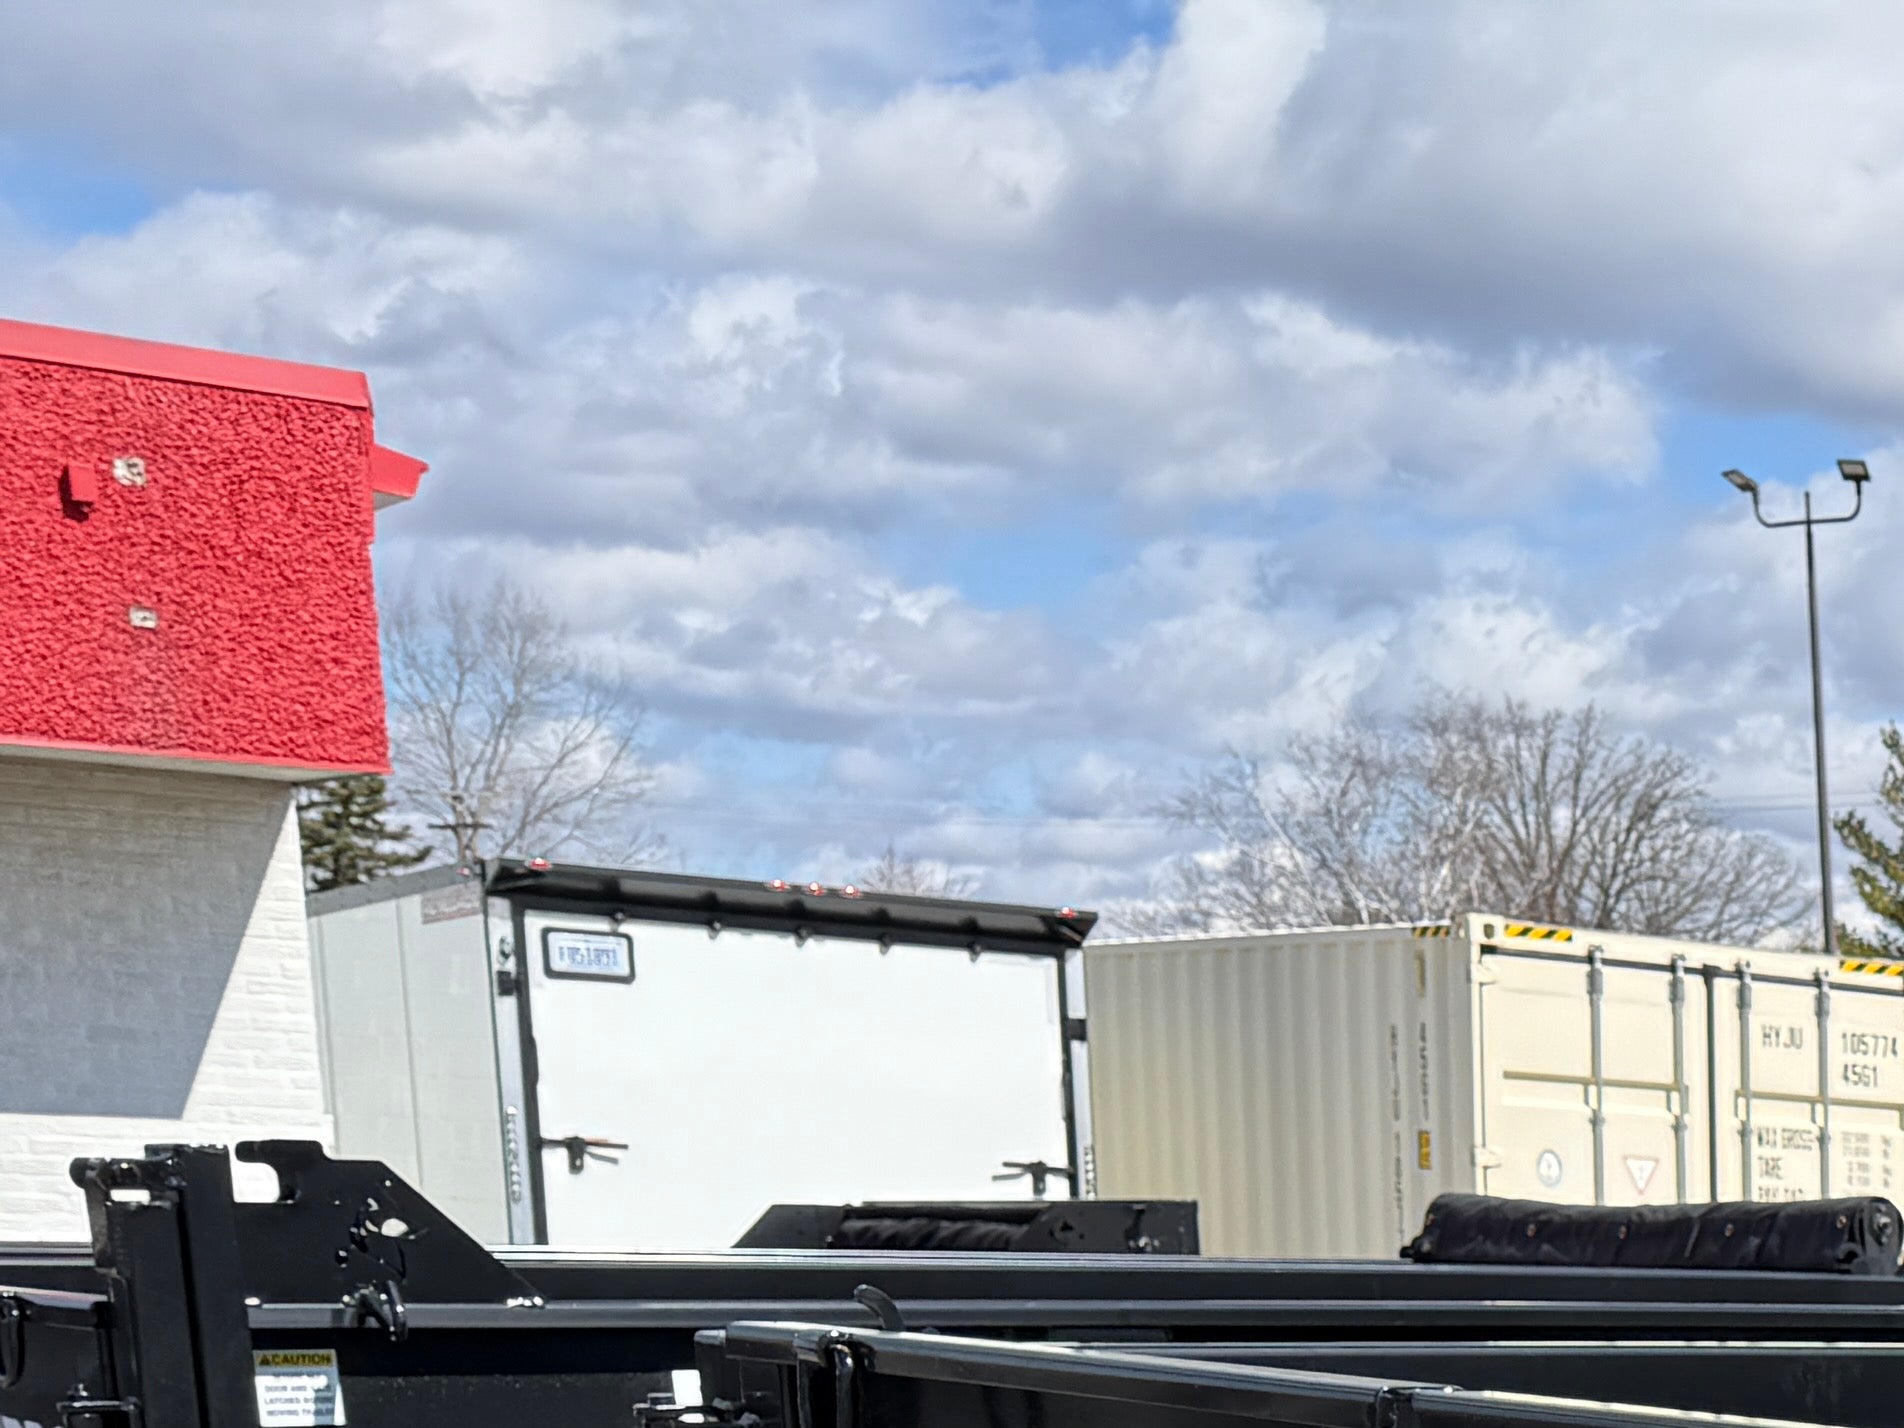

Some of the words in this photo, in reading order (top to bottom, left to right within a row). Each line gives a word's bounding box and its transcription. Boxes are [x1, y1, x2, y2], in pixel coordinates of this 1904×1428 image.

[1760, 1024, 1804, 1050] HYJU
[1840, 1032, 1898, 1058] 105774
[271, 1354, 331, 1366] CAUTION
